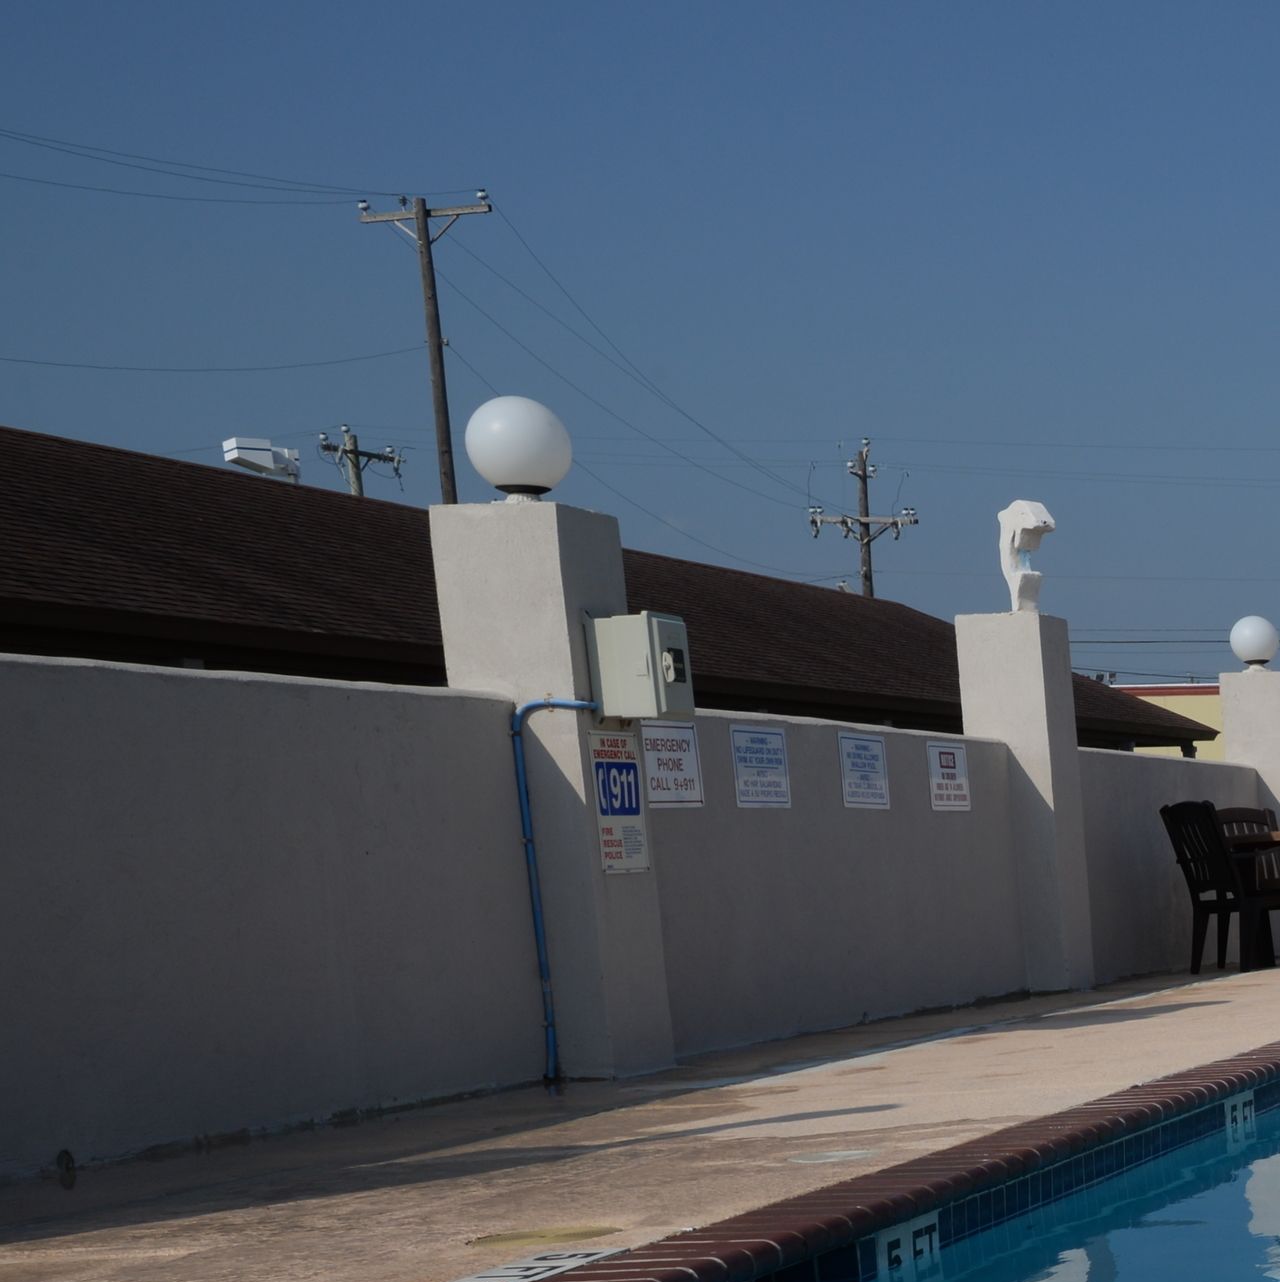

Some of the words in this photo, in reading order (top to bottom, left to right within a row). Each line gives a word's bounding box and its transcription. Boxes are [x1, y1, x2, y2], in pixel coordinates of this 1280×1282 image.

[600, 738, 606, 747] IN
[607, 738, 621, 748] CASE
[622, 739, 628, 749] OF
[645, 738, 691, 752] EMERGENCY
[593, 749, 623, 760] EMERGENCY
[624, 751, 636, 760] CALL
[657, 757, 684, 772] PHONE
[609, 768, 636, 809] 911
[650, 777, 672, 791] CALL
[602, 827, 613, 836] FIRE
[603, 839, 623, 848] RESCUE
[604, 851, 623, 860] POLICE
[887, 1238, 903, 1271] 5
[912, 1222, 938, 1261] FT
